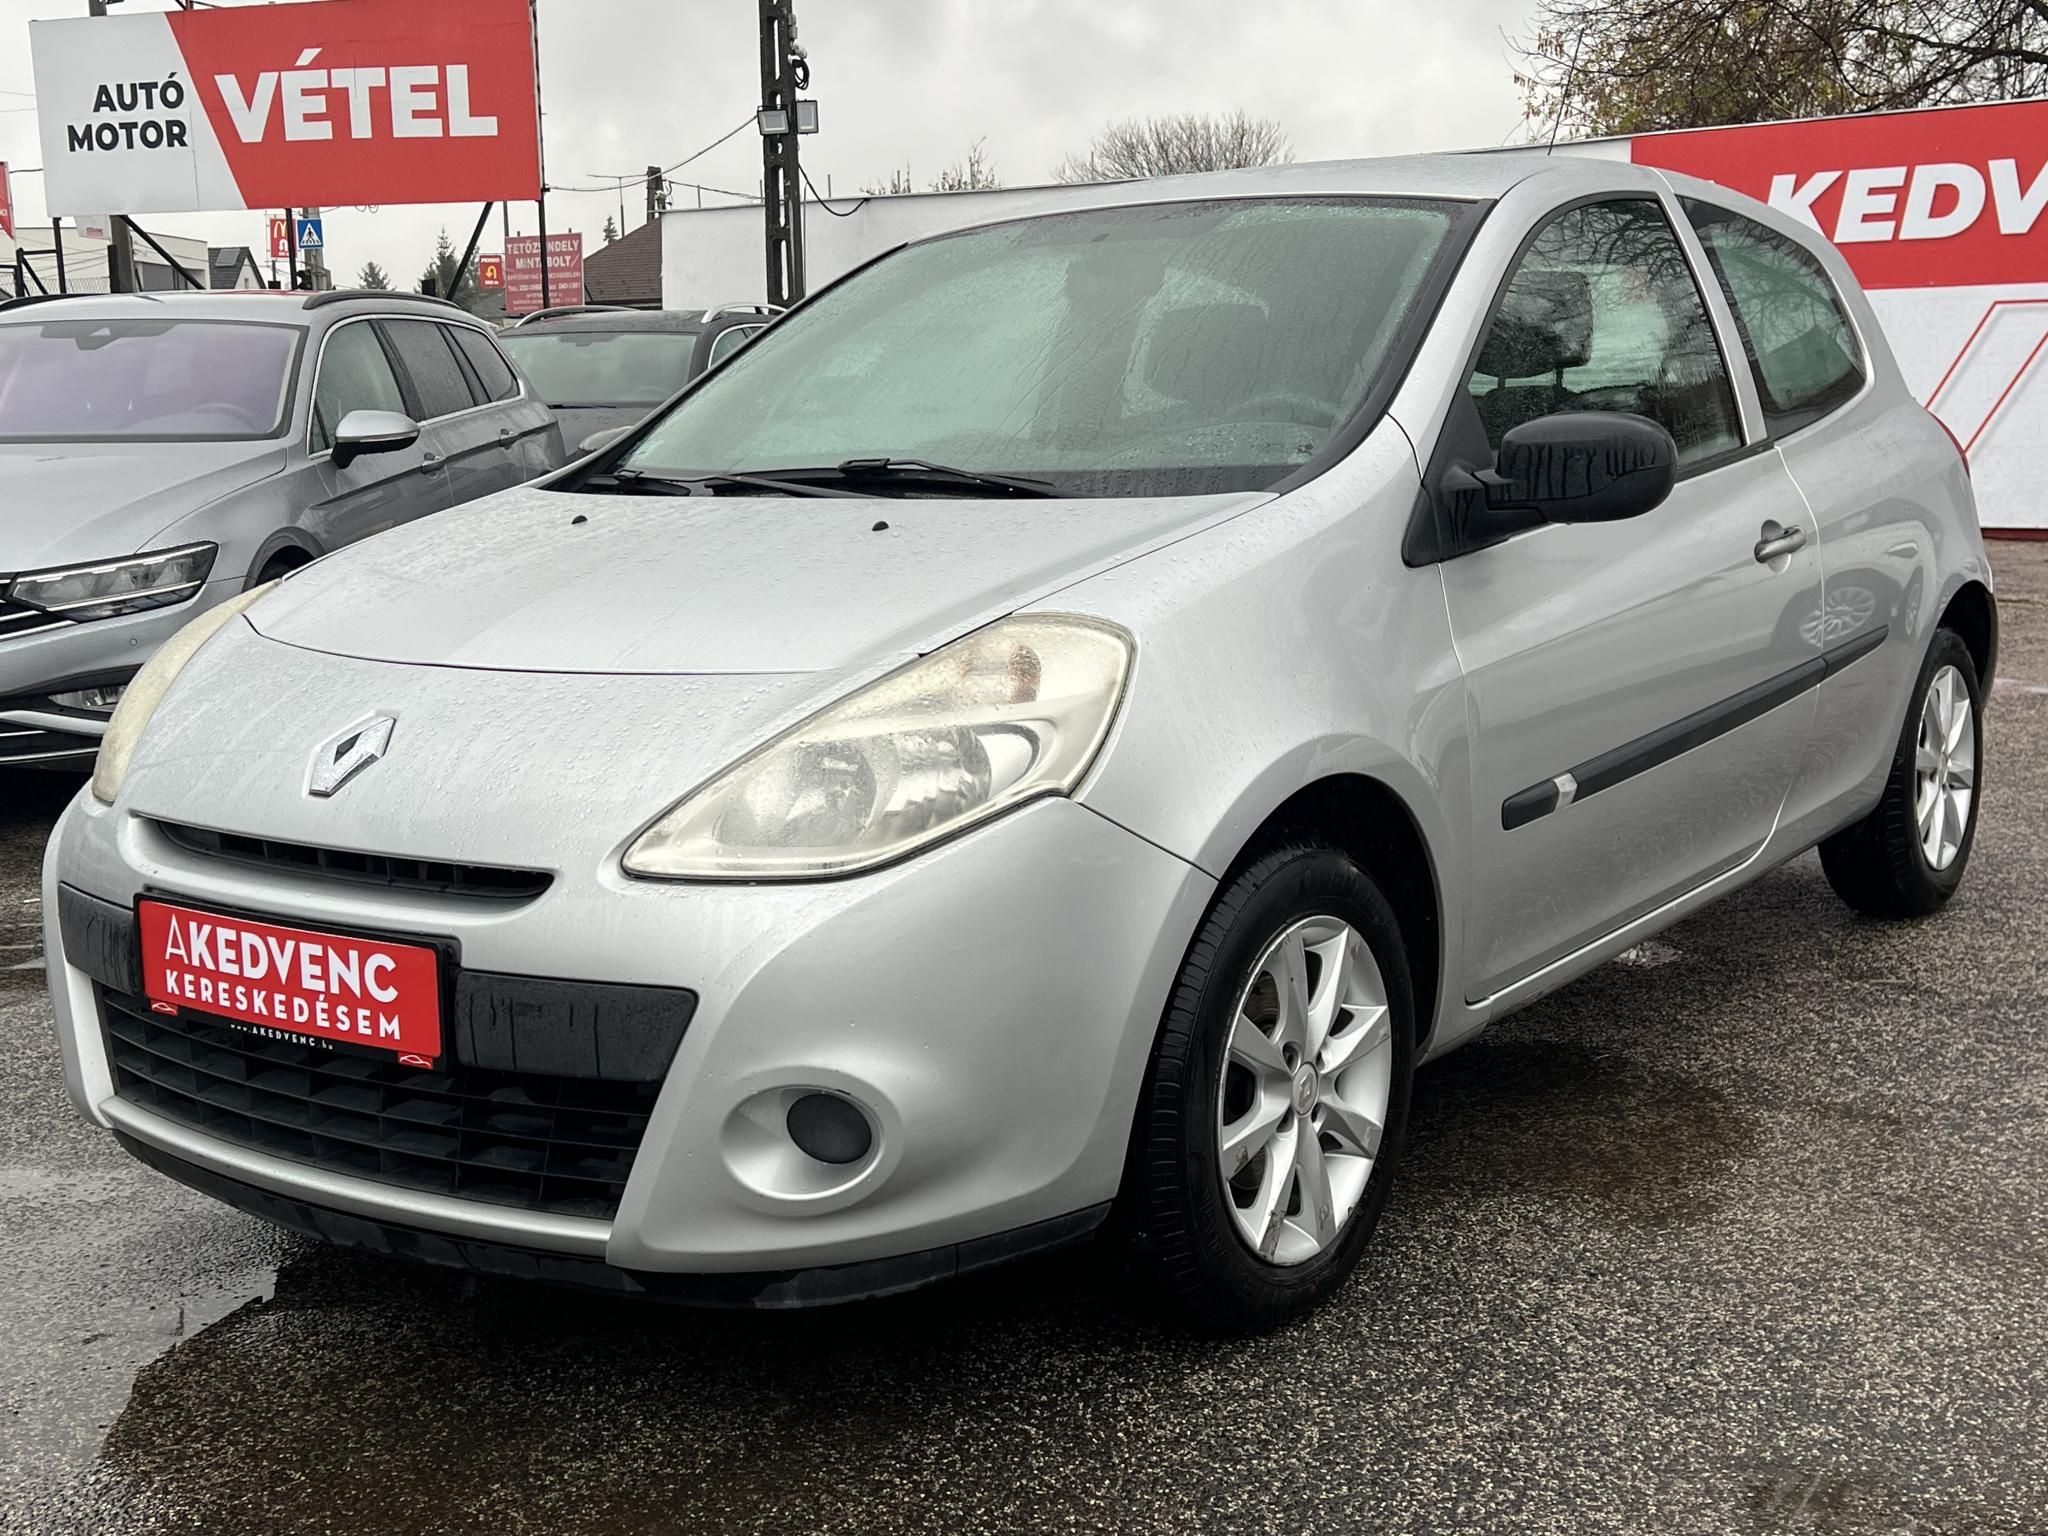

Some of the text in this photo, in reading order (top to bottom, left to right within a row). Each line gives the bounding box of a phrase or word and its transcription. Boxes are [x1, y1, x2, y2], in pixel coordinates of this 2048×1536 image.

[92, 72, 184, 113] AUTÓ
[215, 47, 498, 142] VÉTEL
[67, 119, 188, 152] MOTOR
[165, 969, 401, 1040] KERESKEDÉSEM
